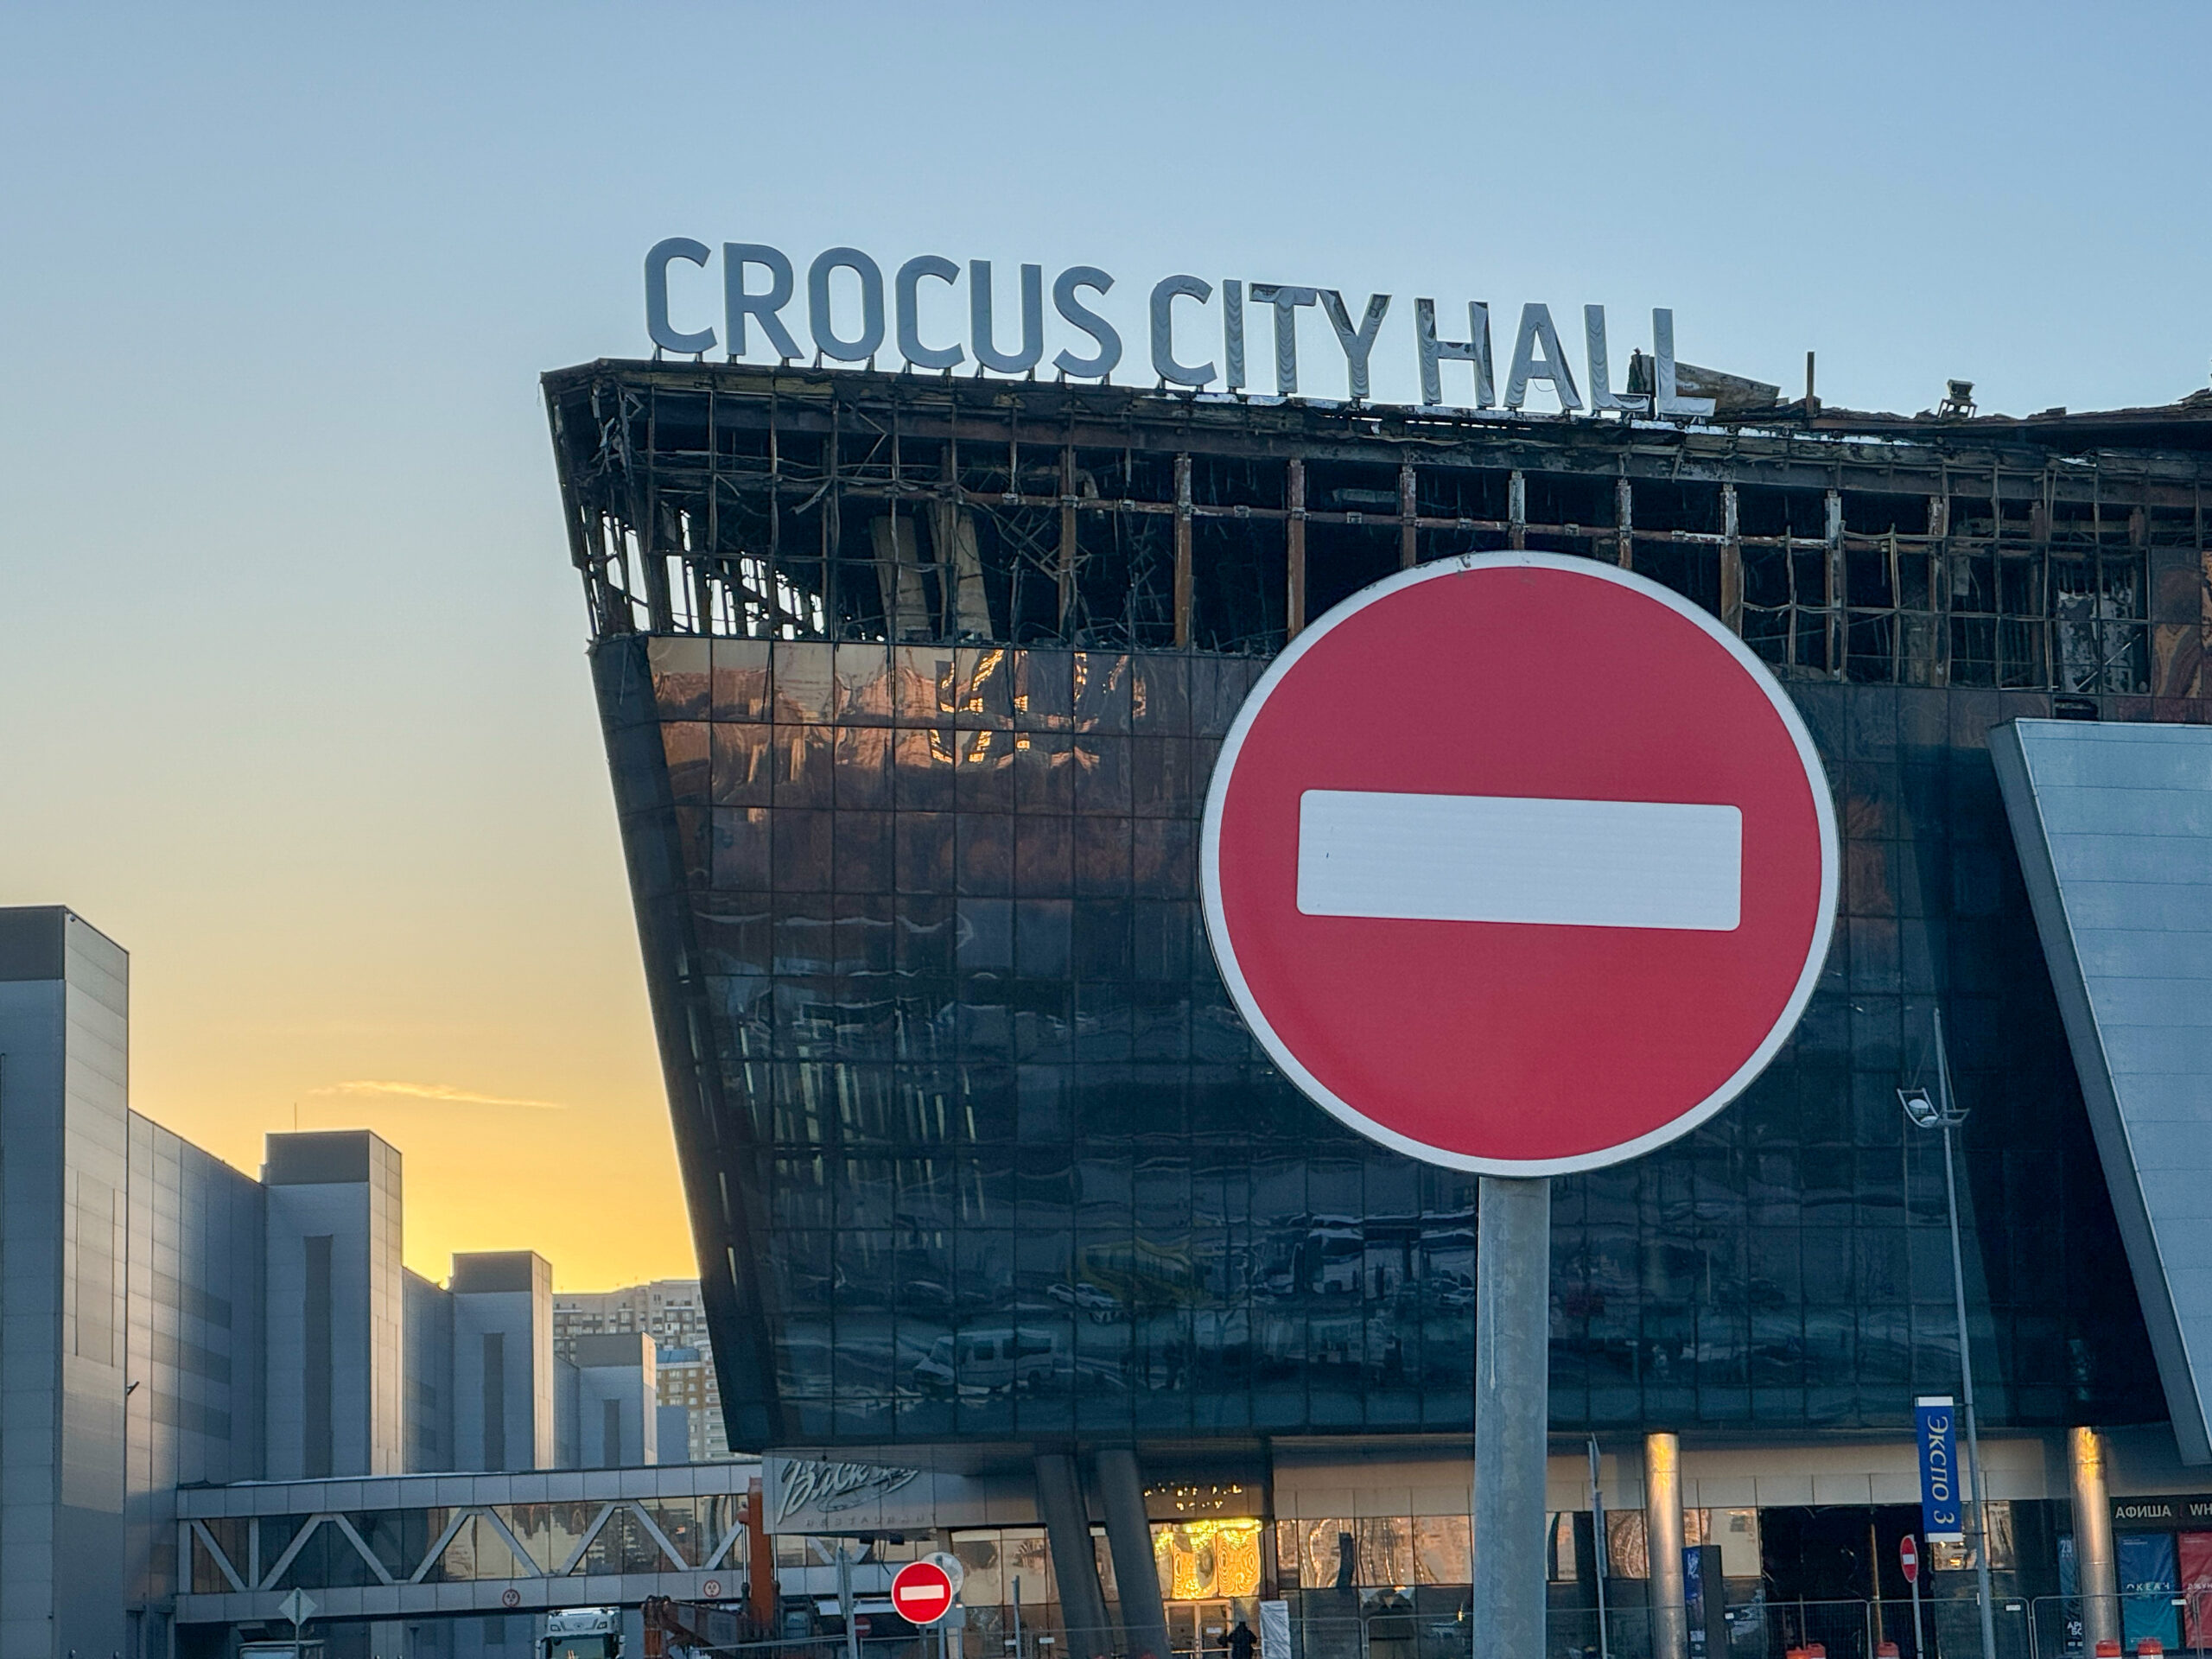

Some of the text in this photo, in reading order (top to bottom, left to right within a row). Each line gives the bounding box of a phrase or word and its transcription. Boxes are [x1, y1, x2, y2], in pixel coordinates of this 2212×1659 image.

[644, 236, 1716, 416] CROCUS CITY HALL
[1927, 1414, 1955, 1524] ЭКСПО 3
[2114, 1504, 2172, 1519] АФИША
